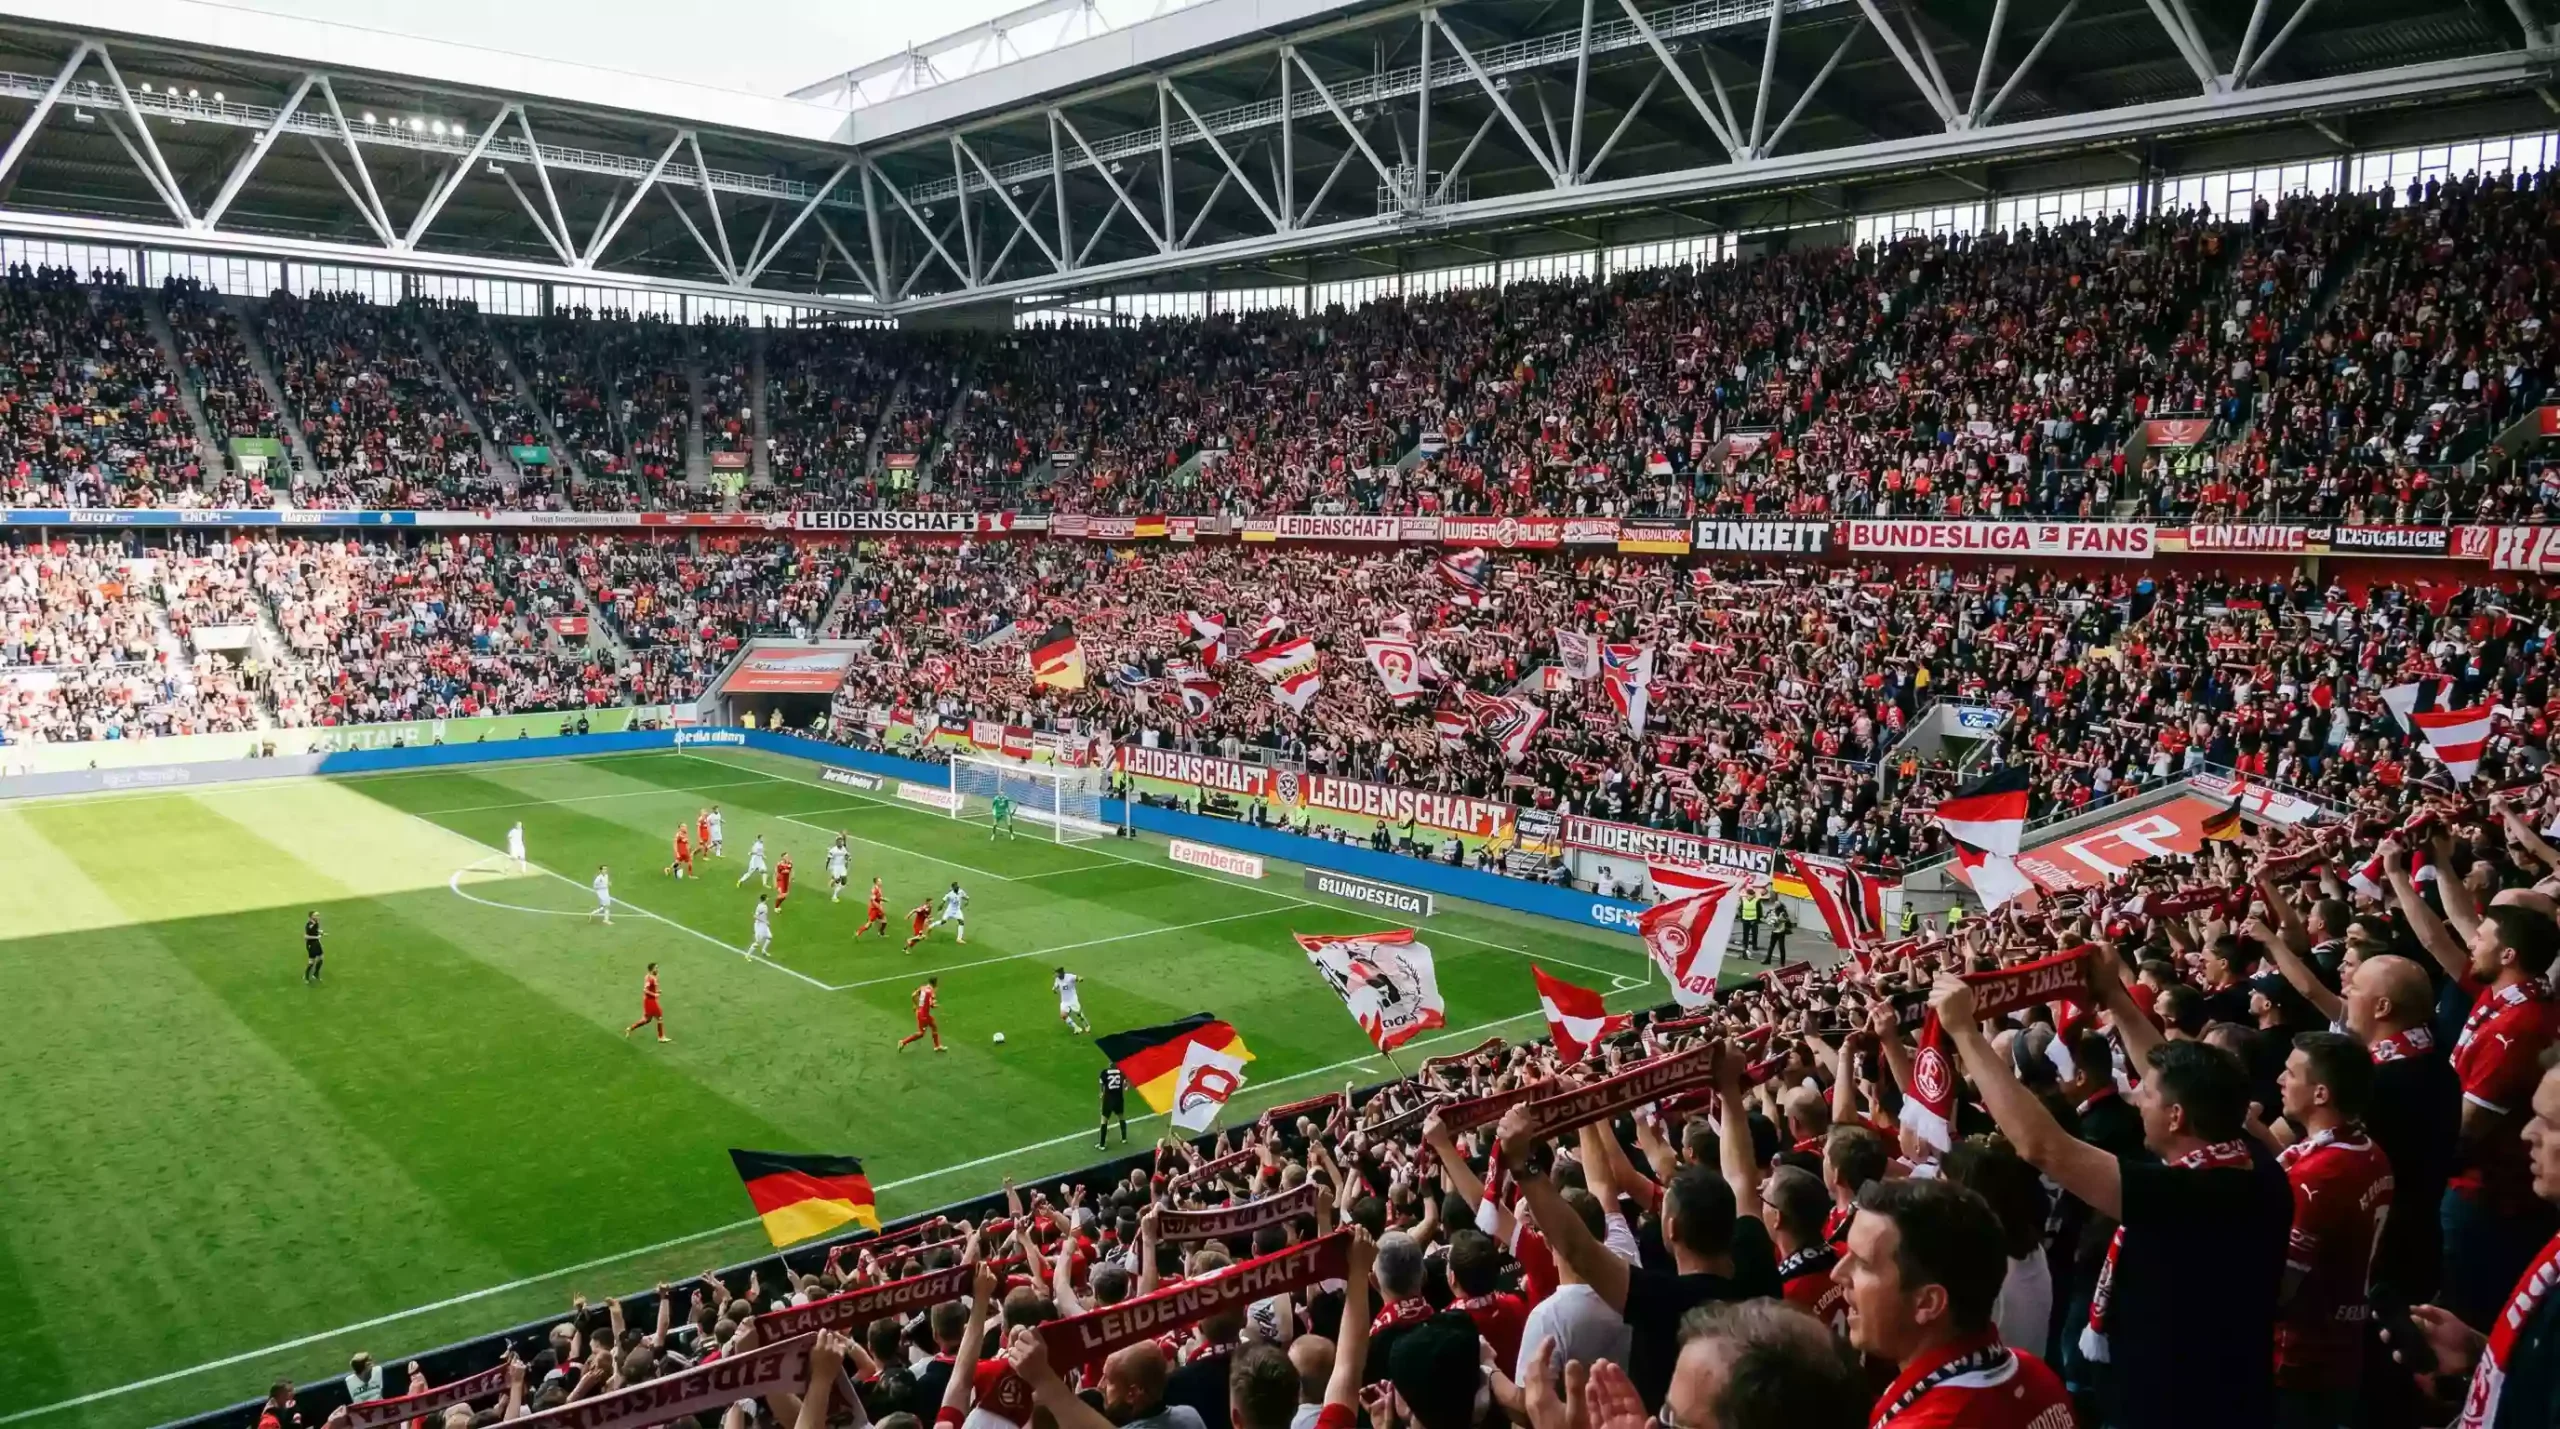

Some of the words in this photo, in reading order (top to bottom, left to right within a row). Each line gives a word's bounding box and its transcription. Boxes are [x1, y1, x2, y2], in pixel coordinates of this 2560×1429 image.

[1280, 518, 1395, 538] LEIDENSCHAFT
[1697, 521, 1829, 552] EINHEIT
[1853, 524, 2031, 550] BUNDESLIGA
[2067, 527, 2148, 552] FANS
[1124, 746, 1268, 795] LEIDENSCHAFT
[1308, 775, 1506, 838] LEIDENSCHAFT
[1079, 1245, 1322, 1349] LEIDENSCHAFT
